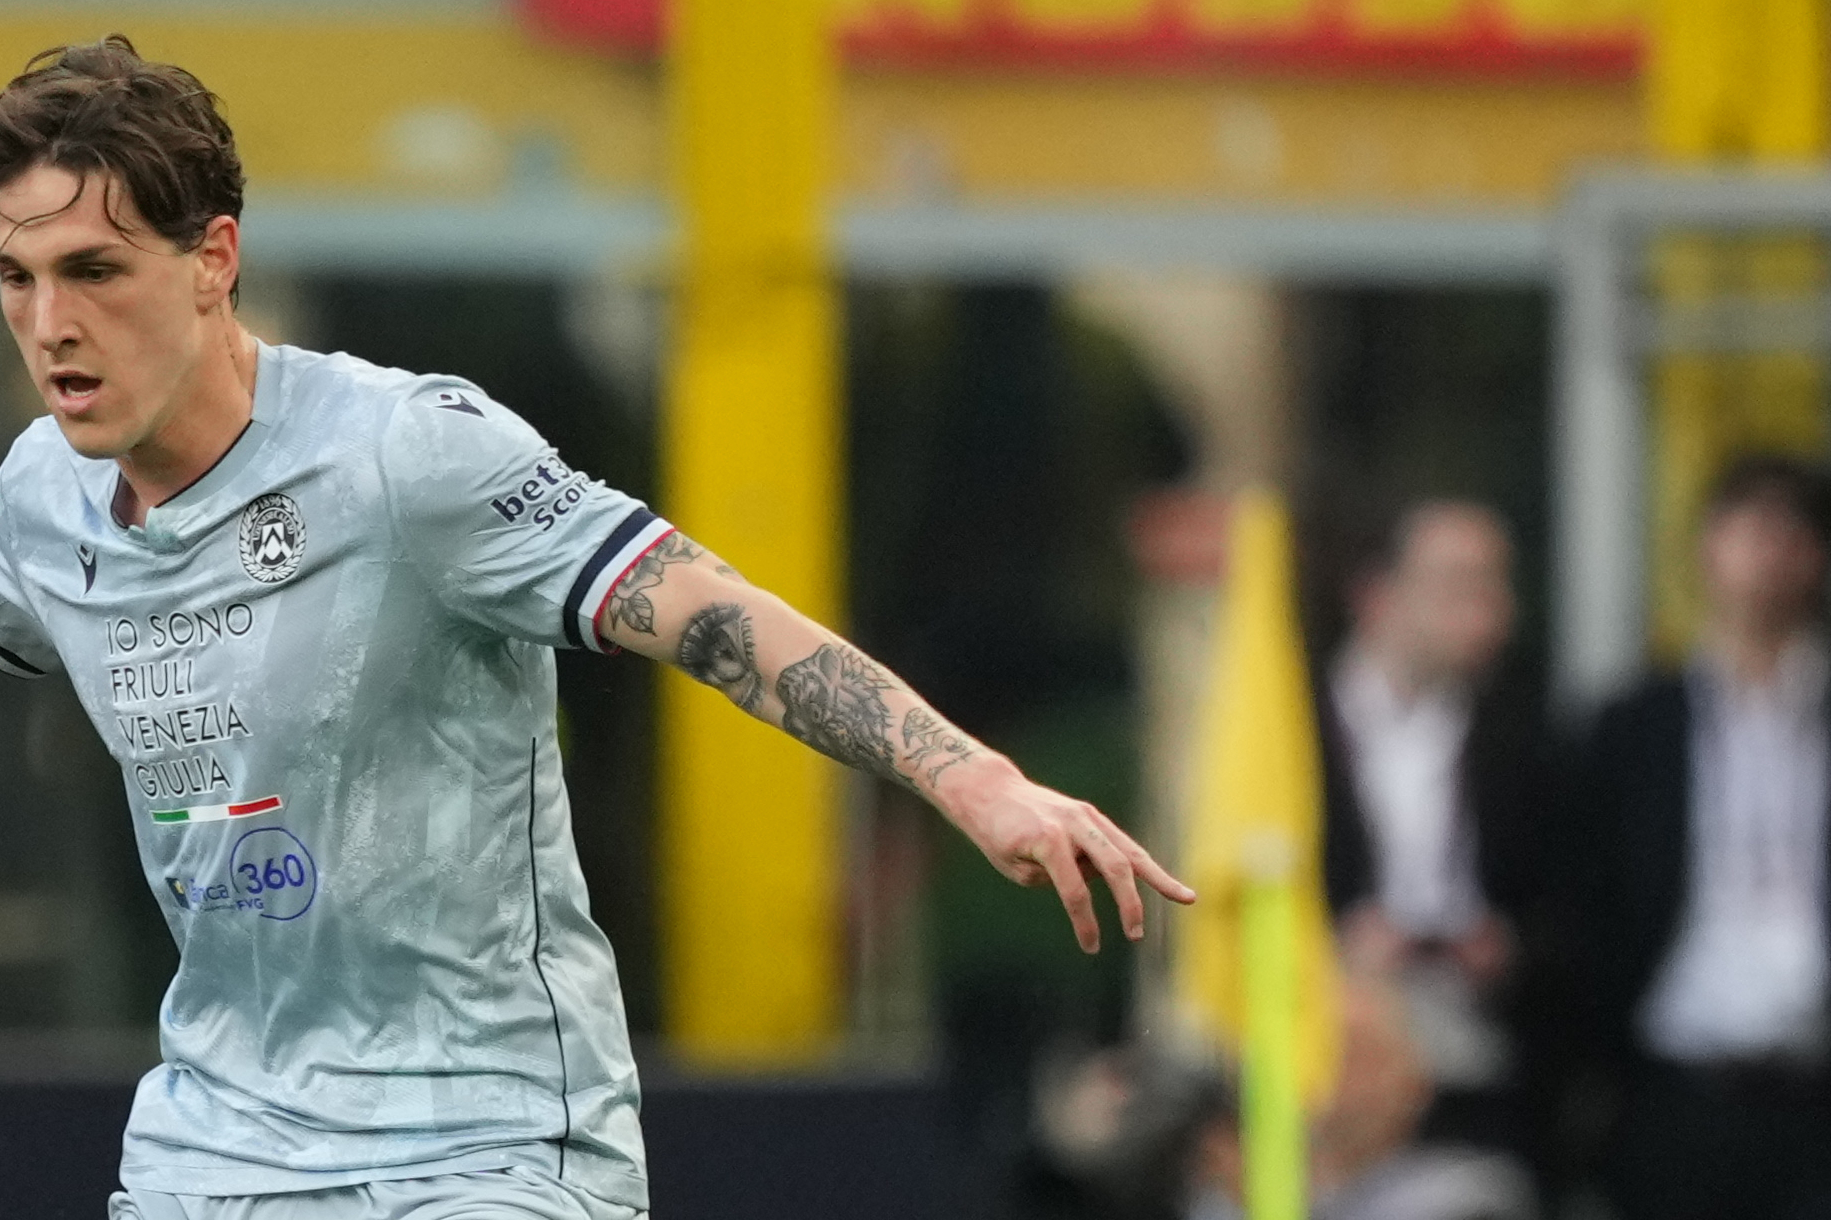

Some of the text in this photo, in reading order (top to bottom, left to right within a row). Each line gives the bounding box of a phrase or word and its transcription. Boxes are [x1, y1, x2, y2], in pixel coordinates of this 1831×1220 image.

[533, 477, 588, 532] Scor
[106, 603, 253, 656] IO SONO
[111, 660, 193, 703] FRIULI
[118, 702, 251, 750] VENEZIA
[135, 756, 233, 798] GIULIA
[237, 854, 305, 895] 360
[236, 898, 265, 911] FVG
